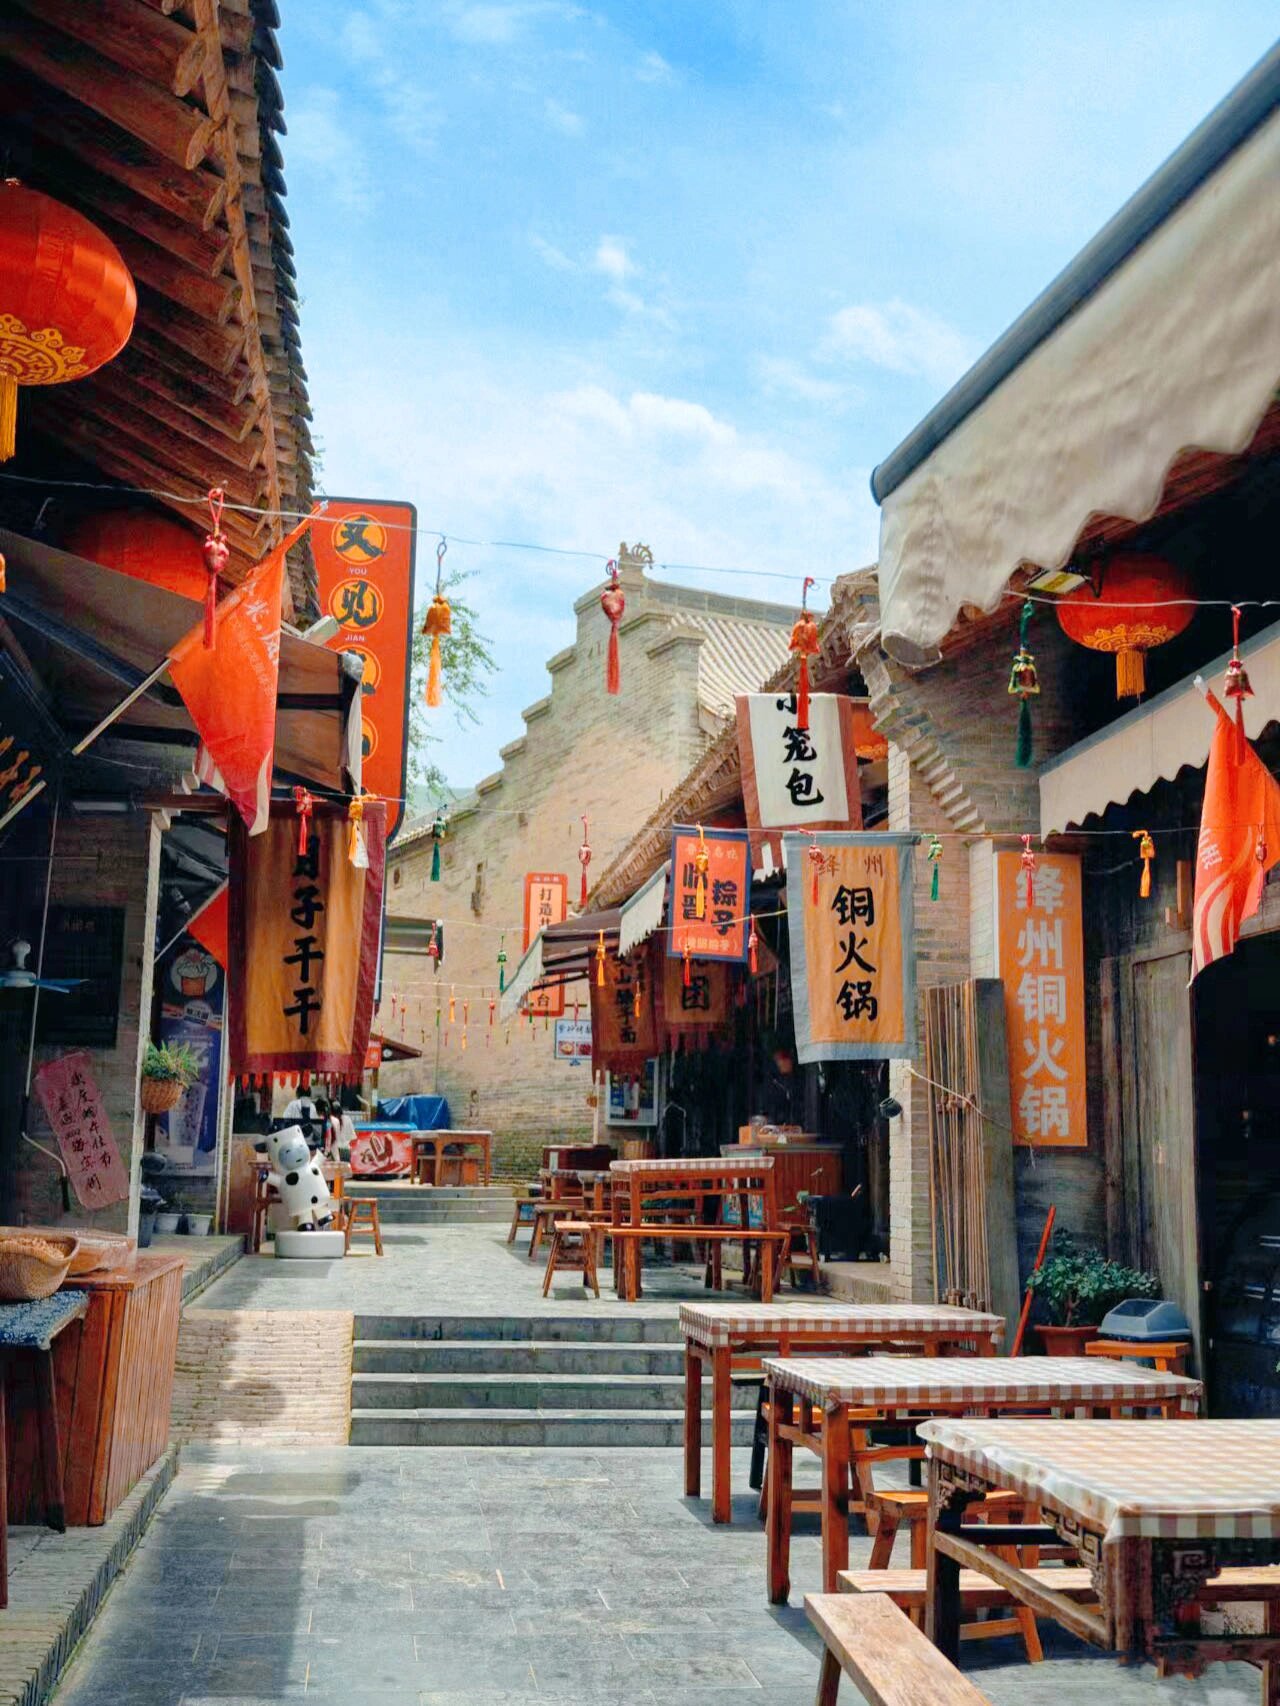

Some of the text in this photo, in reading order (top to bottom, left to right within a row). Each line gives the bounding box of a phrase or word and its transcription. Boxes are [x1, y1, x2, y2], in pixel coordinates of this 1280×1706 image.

[334, 514, 385, 557] 又
[349, 567, 367, 575] YOU
[336, 580, 378, 627] 见
[344, 634, 365, 642] JIAN
[776, 694, 825, 807] 小笼包
[831, 885, 878, 1022] 铜火锅
[1014, 863, 1070, 1138] 绛州铜火锅
